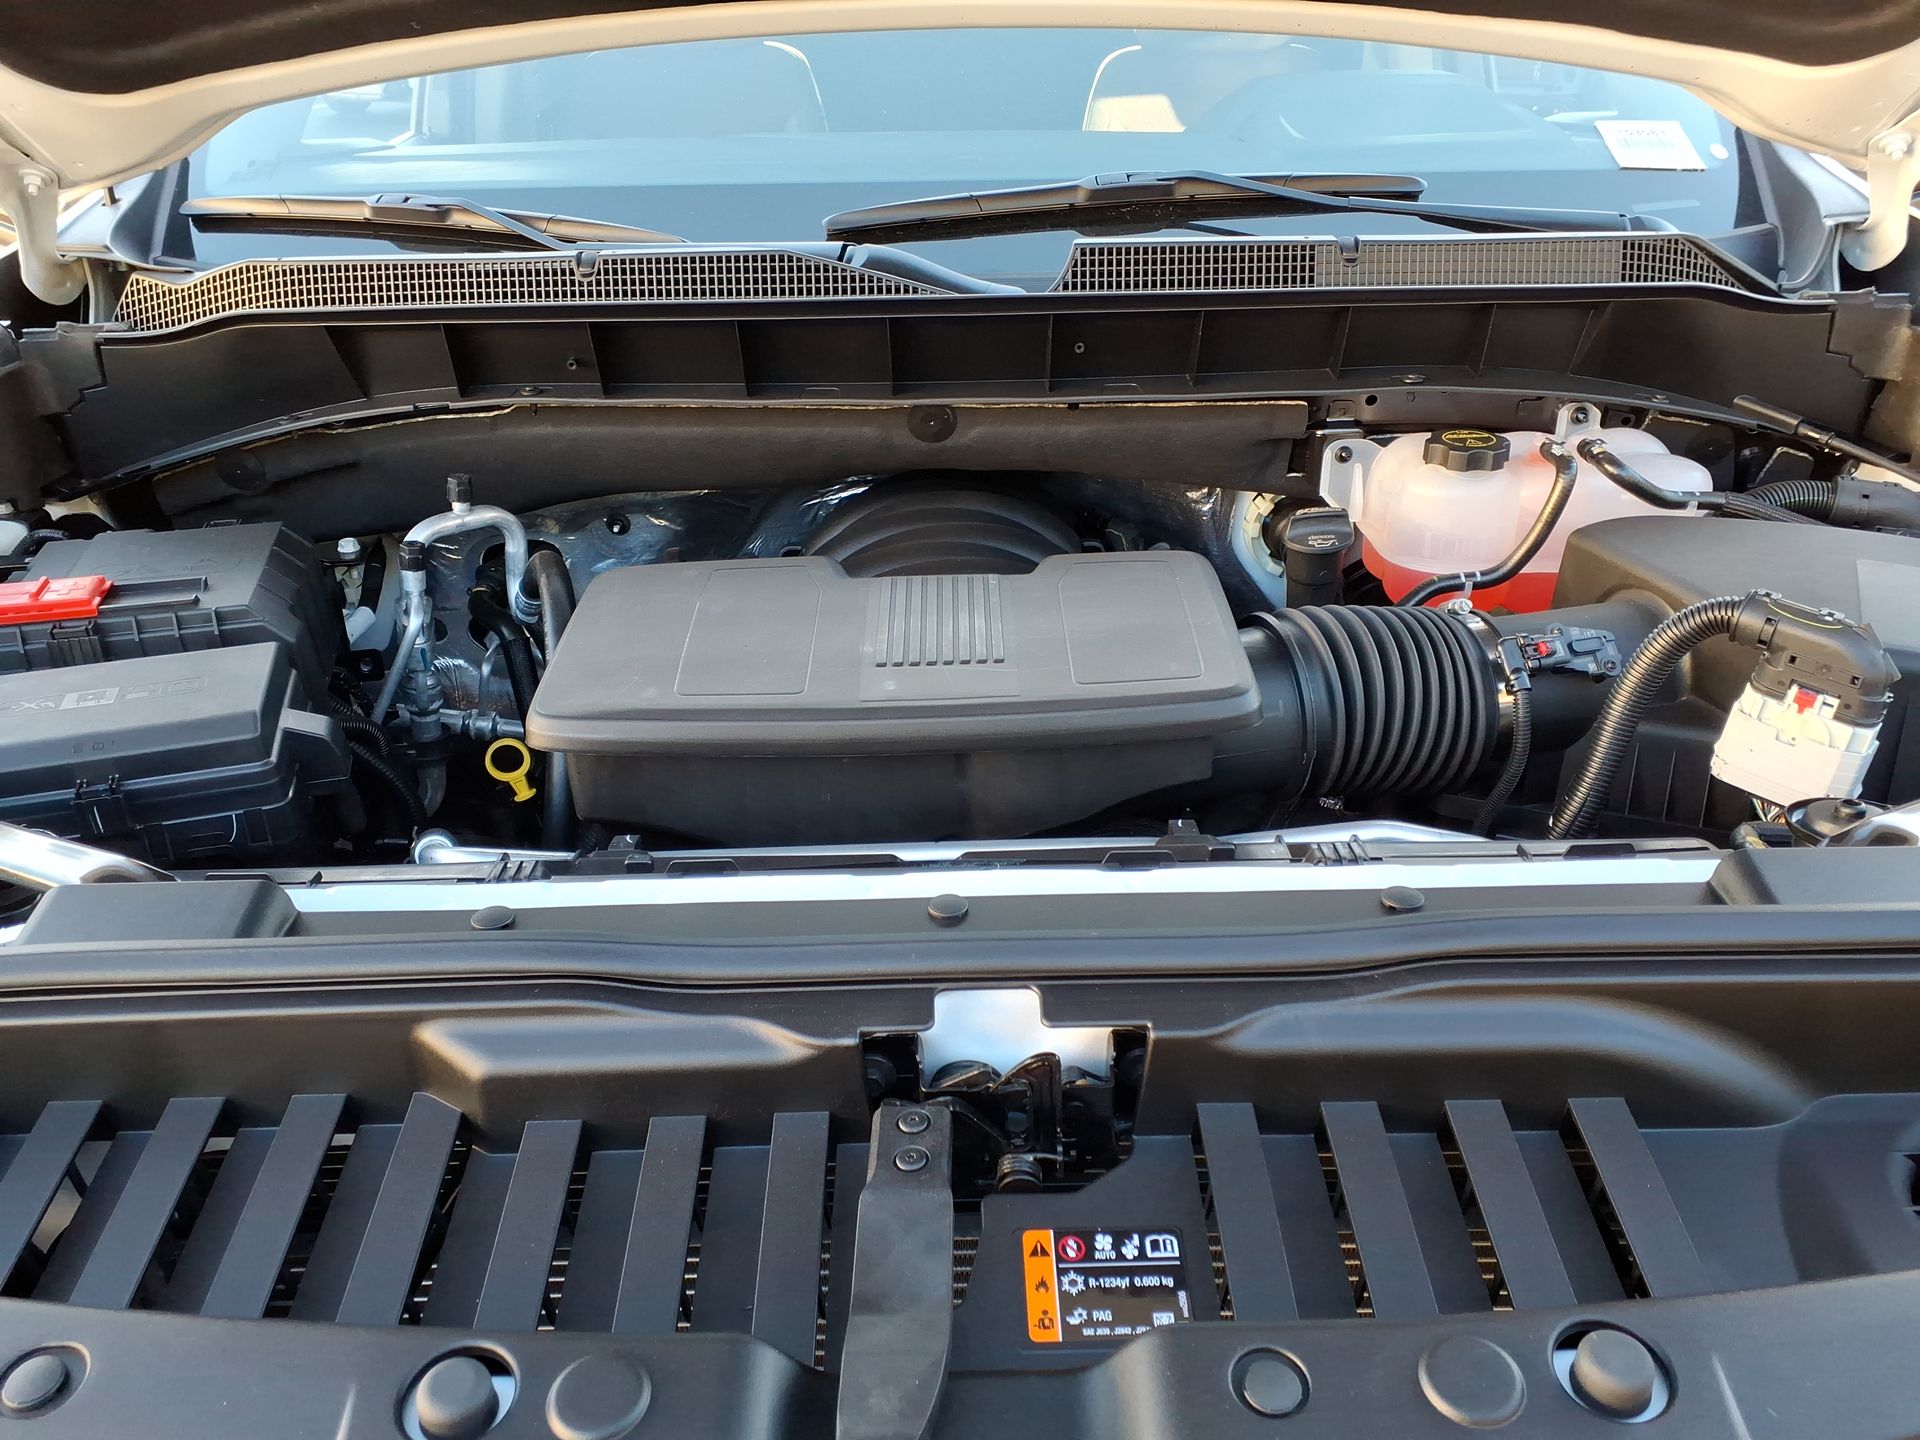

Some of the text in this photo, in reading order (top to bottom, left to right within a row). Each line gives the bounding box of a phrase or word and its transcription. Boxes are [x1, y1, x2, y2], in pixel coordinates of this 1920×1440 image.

[1094, 1250, 1117, 1260] AUTO
[1088, 1275, 1174, 1289] R-1234yf 0.600 kg
[1092, 1310, 1112, 1322] PAG
